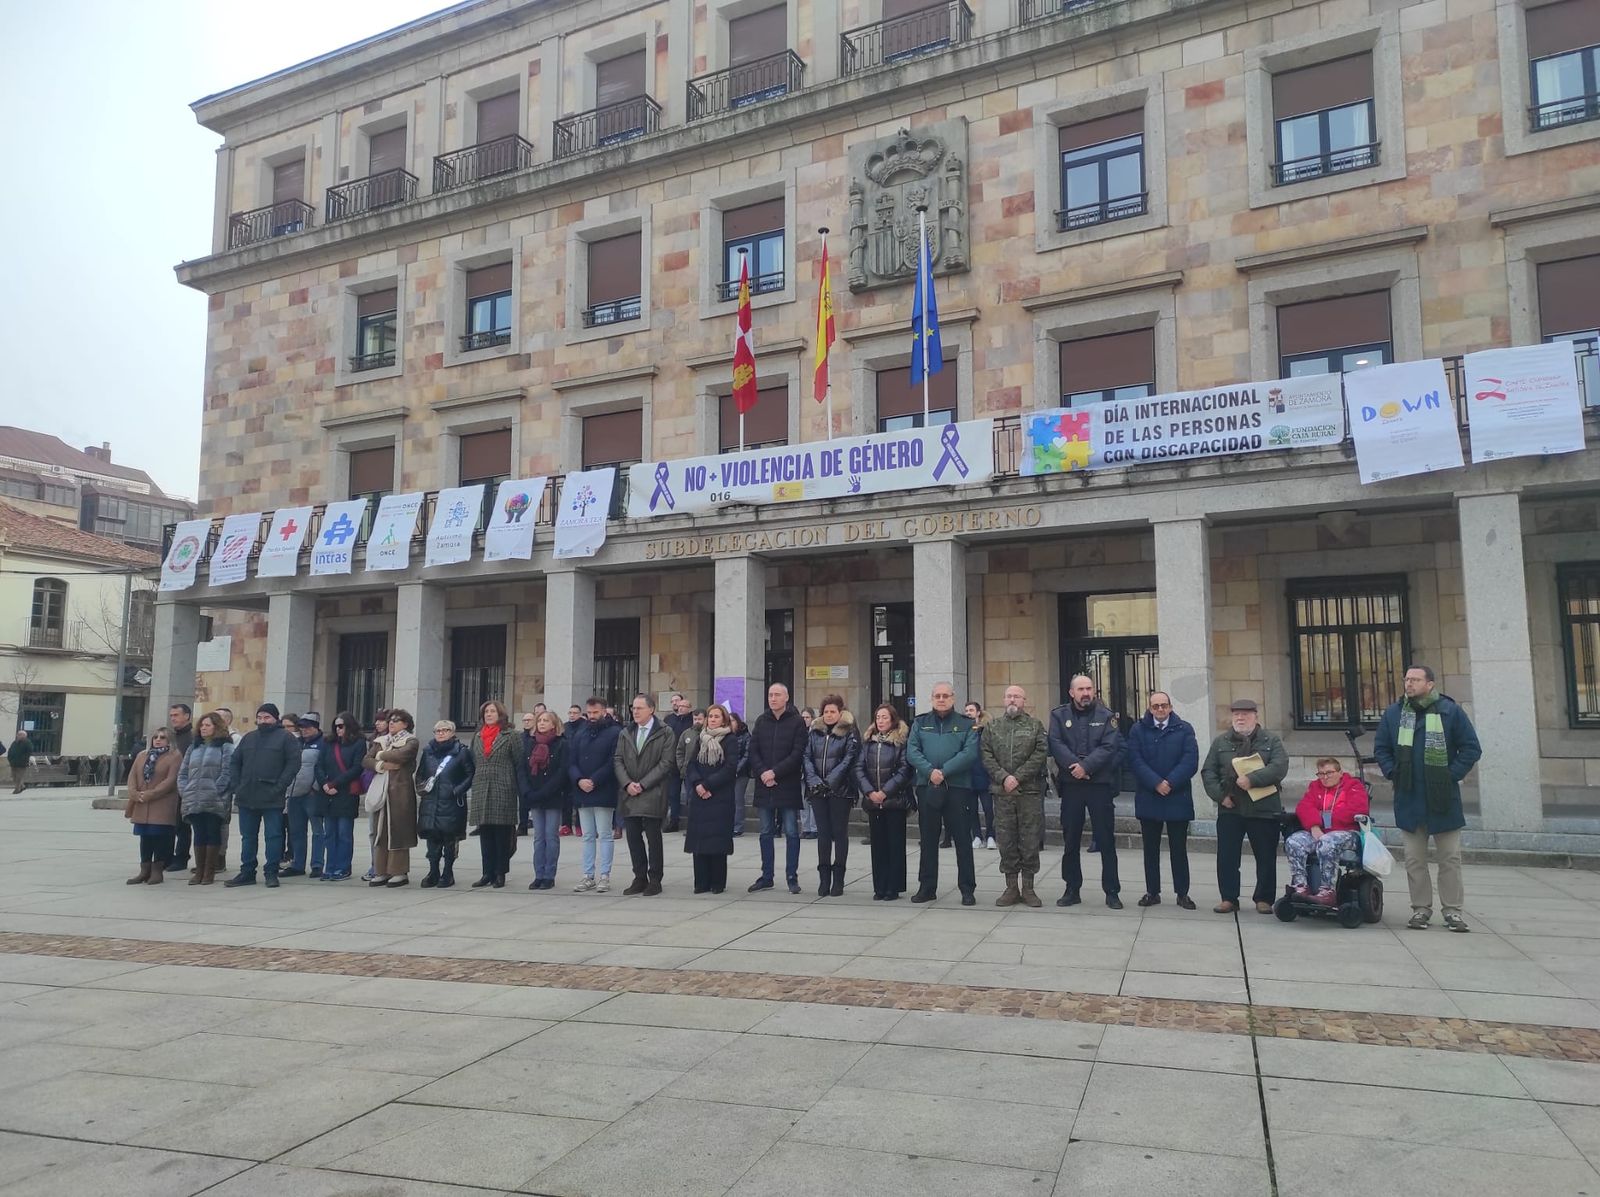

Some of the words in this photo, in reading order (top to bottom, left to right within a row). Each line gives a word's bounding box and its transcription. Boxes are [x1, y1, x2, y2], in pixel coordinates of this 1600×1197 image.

[1104, 404, 1129, 424] DÍA
[1135, 388, 1261, 420] INTERNACIONAL
[1105, 429, 1125, 445] DE
[1132, 425, 1162, 442] LAS
[1170, 412, 1262, 438] PERSONAS
[685, 465, 707, 492] NO
[721, 452, 815, 488] VIOLENCIA
[820, 448, 844, 478] DE
[849, 438, 924, 475] GÉNERO
[1103, 448, 1135, 464] CON
[1141, 434, 1262, 460] DISCAPACIDAD
[710, 491, 731, 502] 016
[646, 525, 829, 560] SUBDELEGACION
[844, 519, 891, 542] DEL
[903, 507, 1041, 538] GOBIERNO
[315, 552, 347, 565] intras
